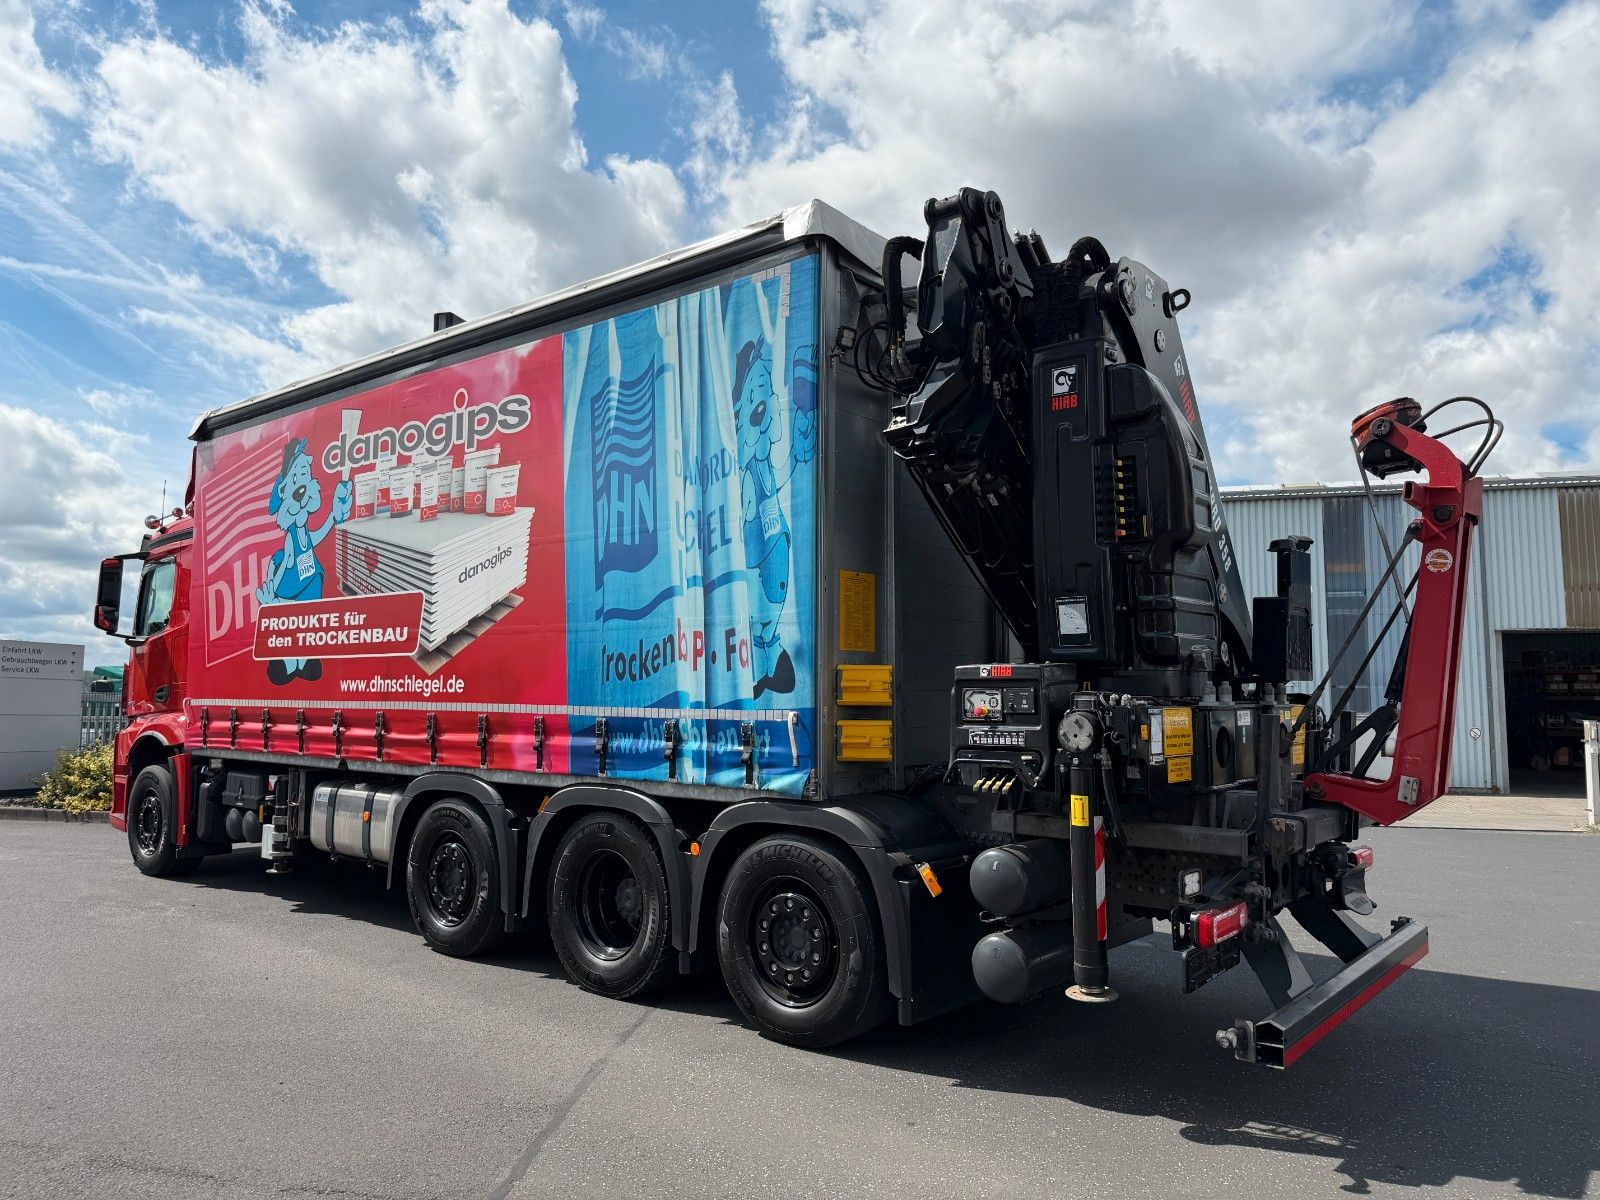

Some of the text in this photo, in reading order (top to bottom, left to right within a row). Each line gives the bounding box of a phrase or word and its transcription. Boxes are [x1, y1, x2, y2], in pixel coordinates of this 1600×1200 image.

[1052, 394, 1078, 411] HIAB
[322, 388, 532, 474] danogips
[596, 466, 655, 563] DHN
[458, 545, 512, 584] danogips
[261, 612, 367, 631] PRODUKTE für
[268, 627, 409, 648] den TROCKENBAU
[2, 646, 27, 654] Einfahrt
[2, 656, 53, 666] Gebrauchtwagen
[991, 666, 1012, 677] HIAB
[340, 674, 465, 697] www.dhnschlegel.de
[762, 845, 835, 881] MICHELIN
